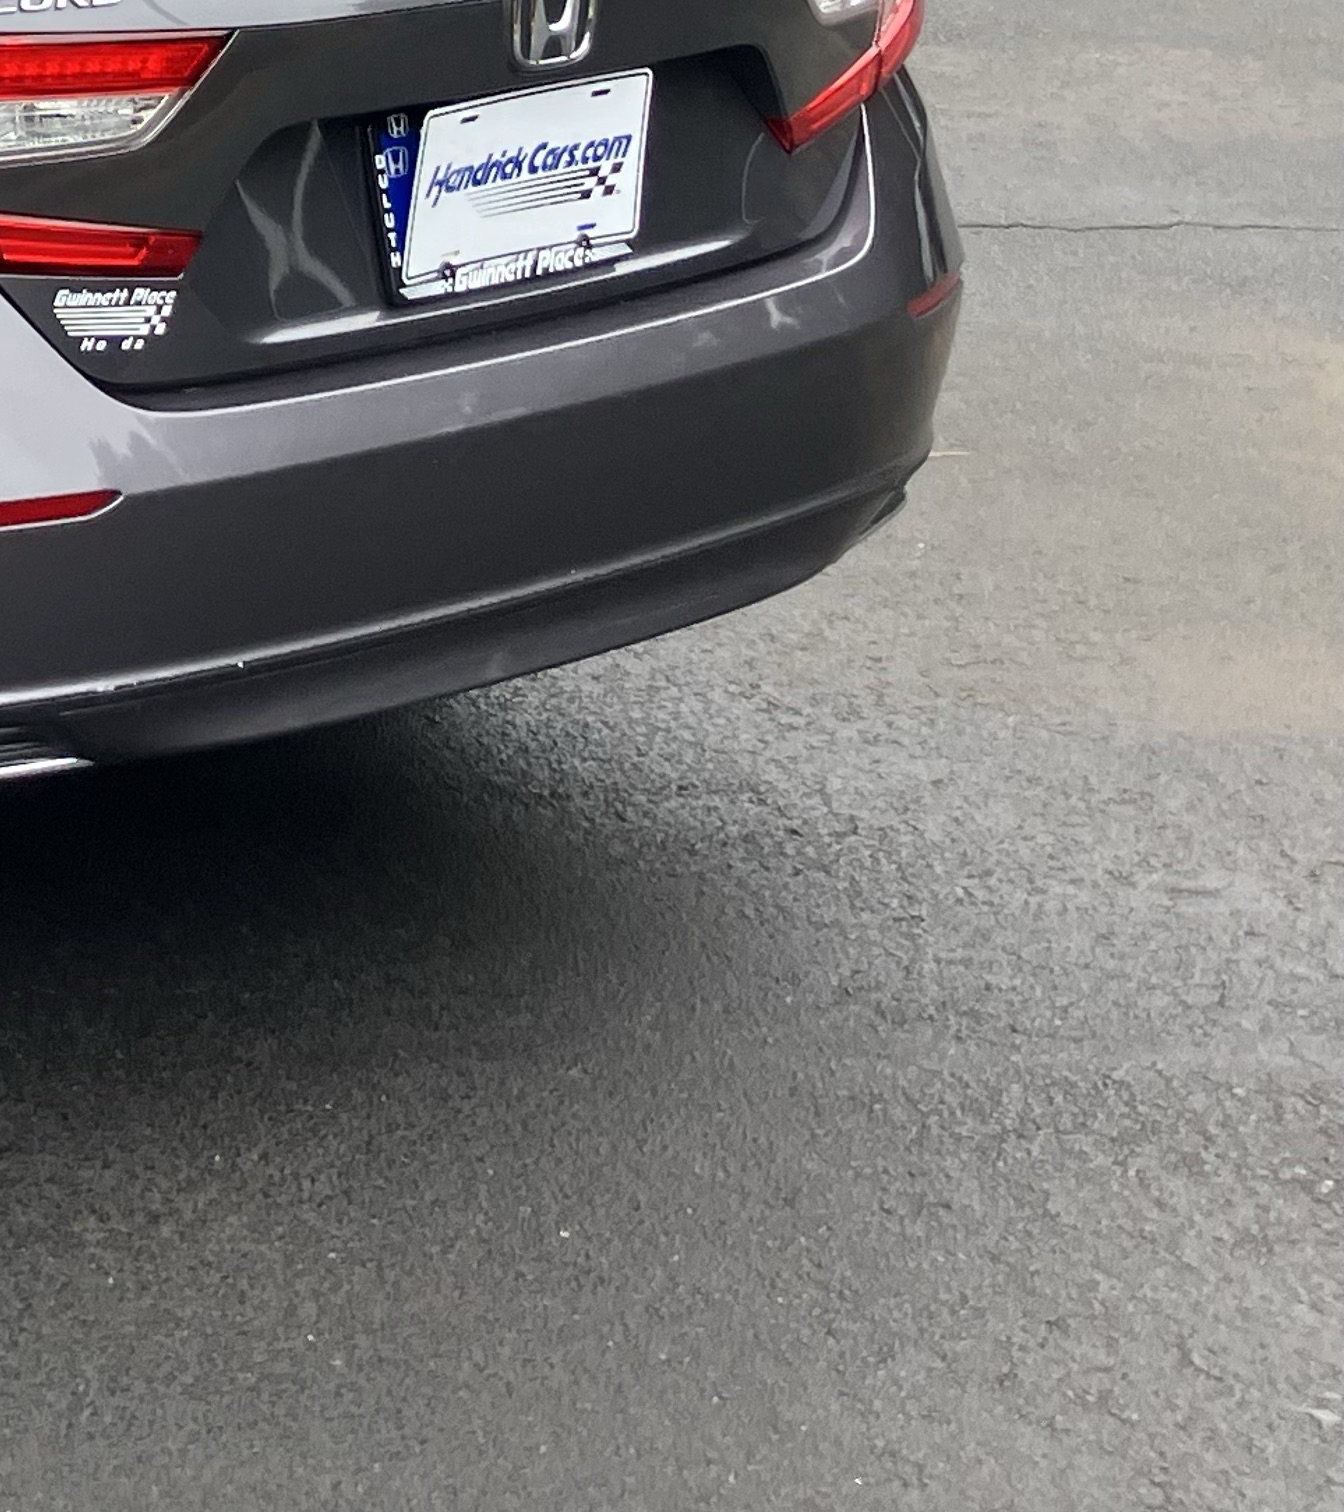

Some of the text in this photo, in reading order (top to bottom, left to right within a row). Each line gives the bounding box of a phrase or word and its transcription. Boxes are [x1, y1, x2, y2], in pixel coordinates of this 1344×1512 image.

[374, 153, 403, 269] DULUTH
[454, 248, 538, 291] Gwinnett
[52, 287, 178, 307] Gwinnett Place
